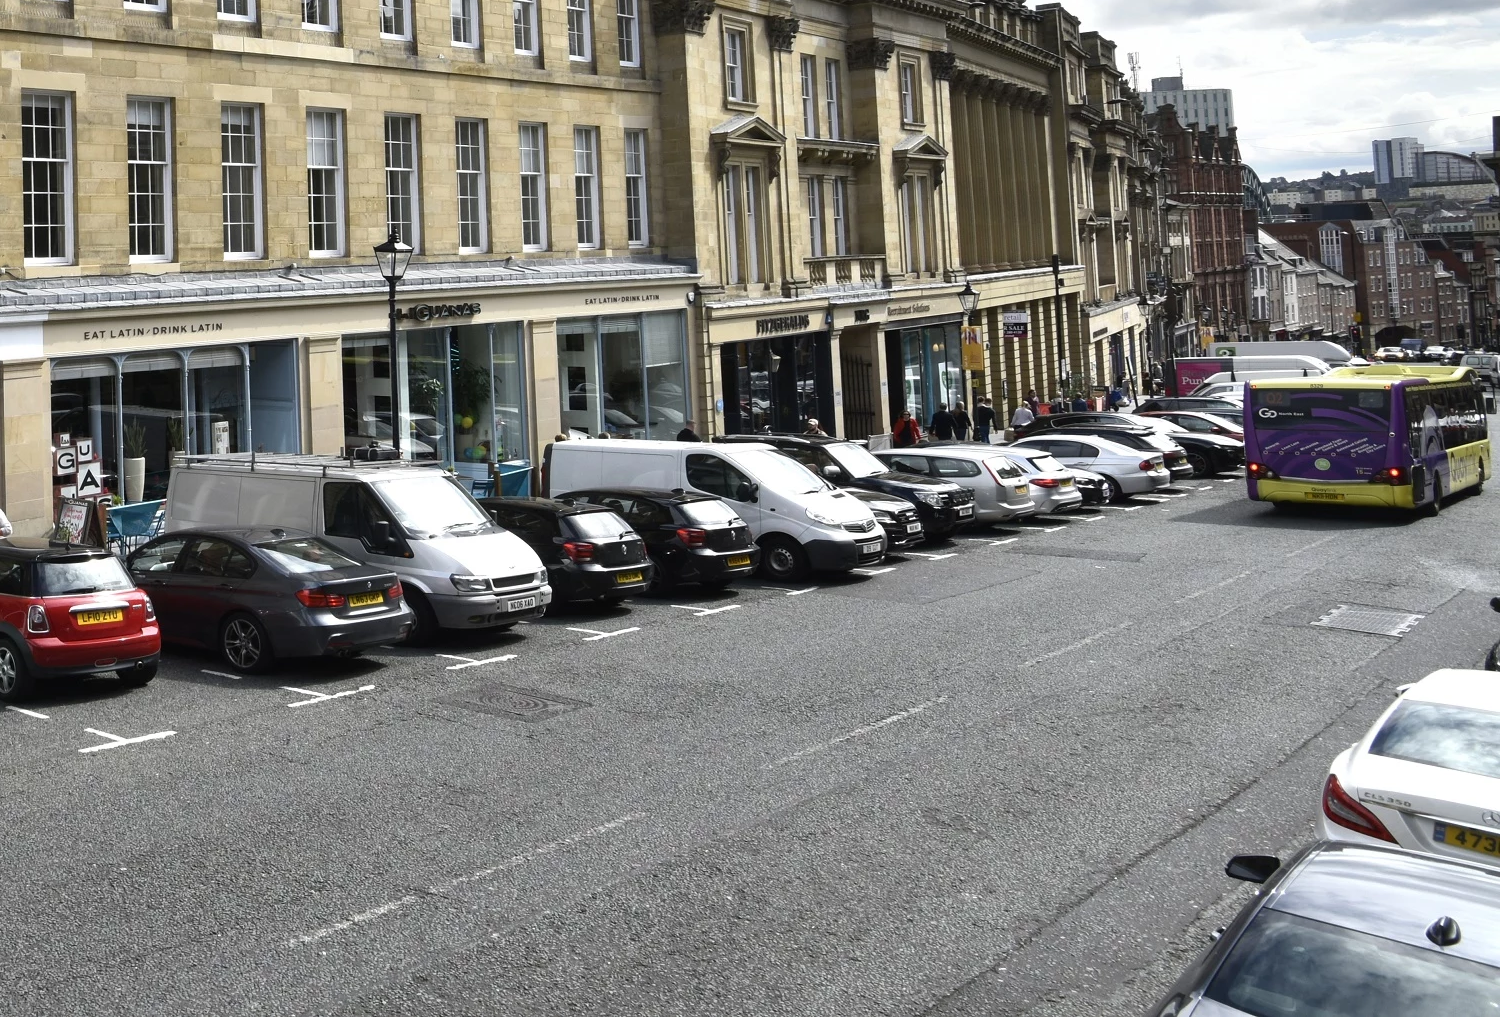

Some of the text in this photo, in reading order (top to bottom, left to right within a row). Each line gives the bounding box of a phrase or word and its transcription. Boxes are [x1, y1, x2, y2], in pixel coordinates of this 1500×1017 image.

[641, 294, 660, 302] LATIN
[83, 330, 106, 340] EAT
[191, 322, 223, 333] LATIN
[756, 314, 810, 334] FITZGERALDS
[58, 452, 75, 470] G
[79, 468, 100, 491] A
[82, 611, 118, 623] LF10 ZTU
[1455, 830, 1500, 853] 473
